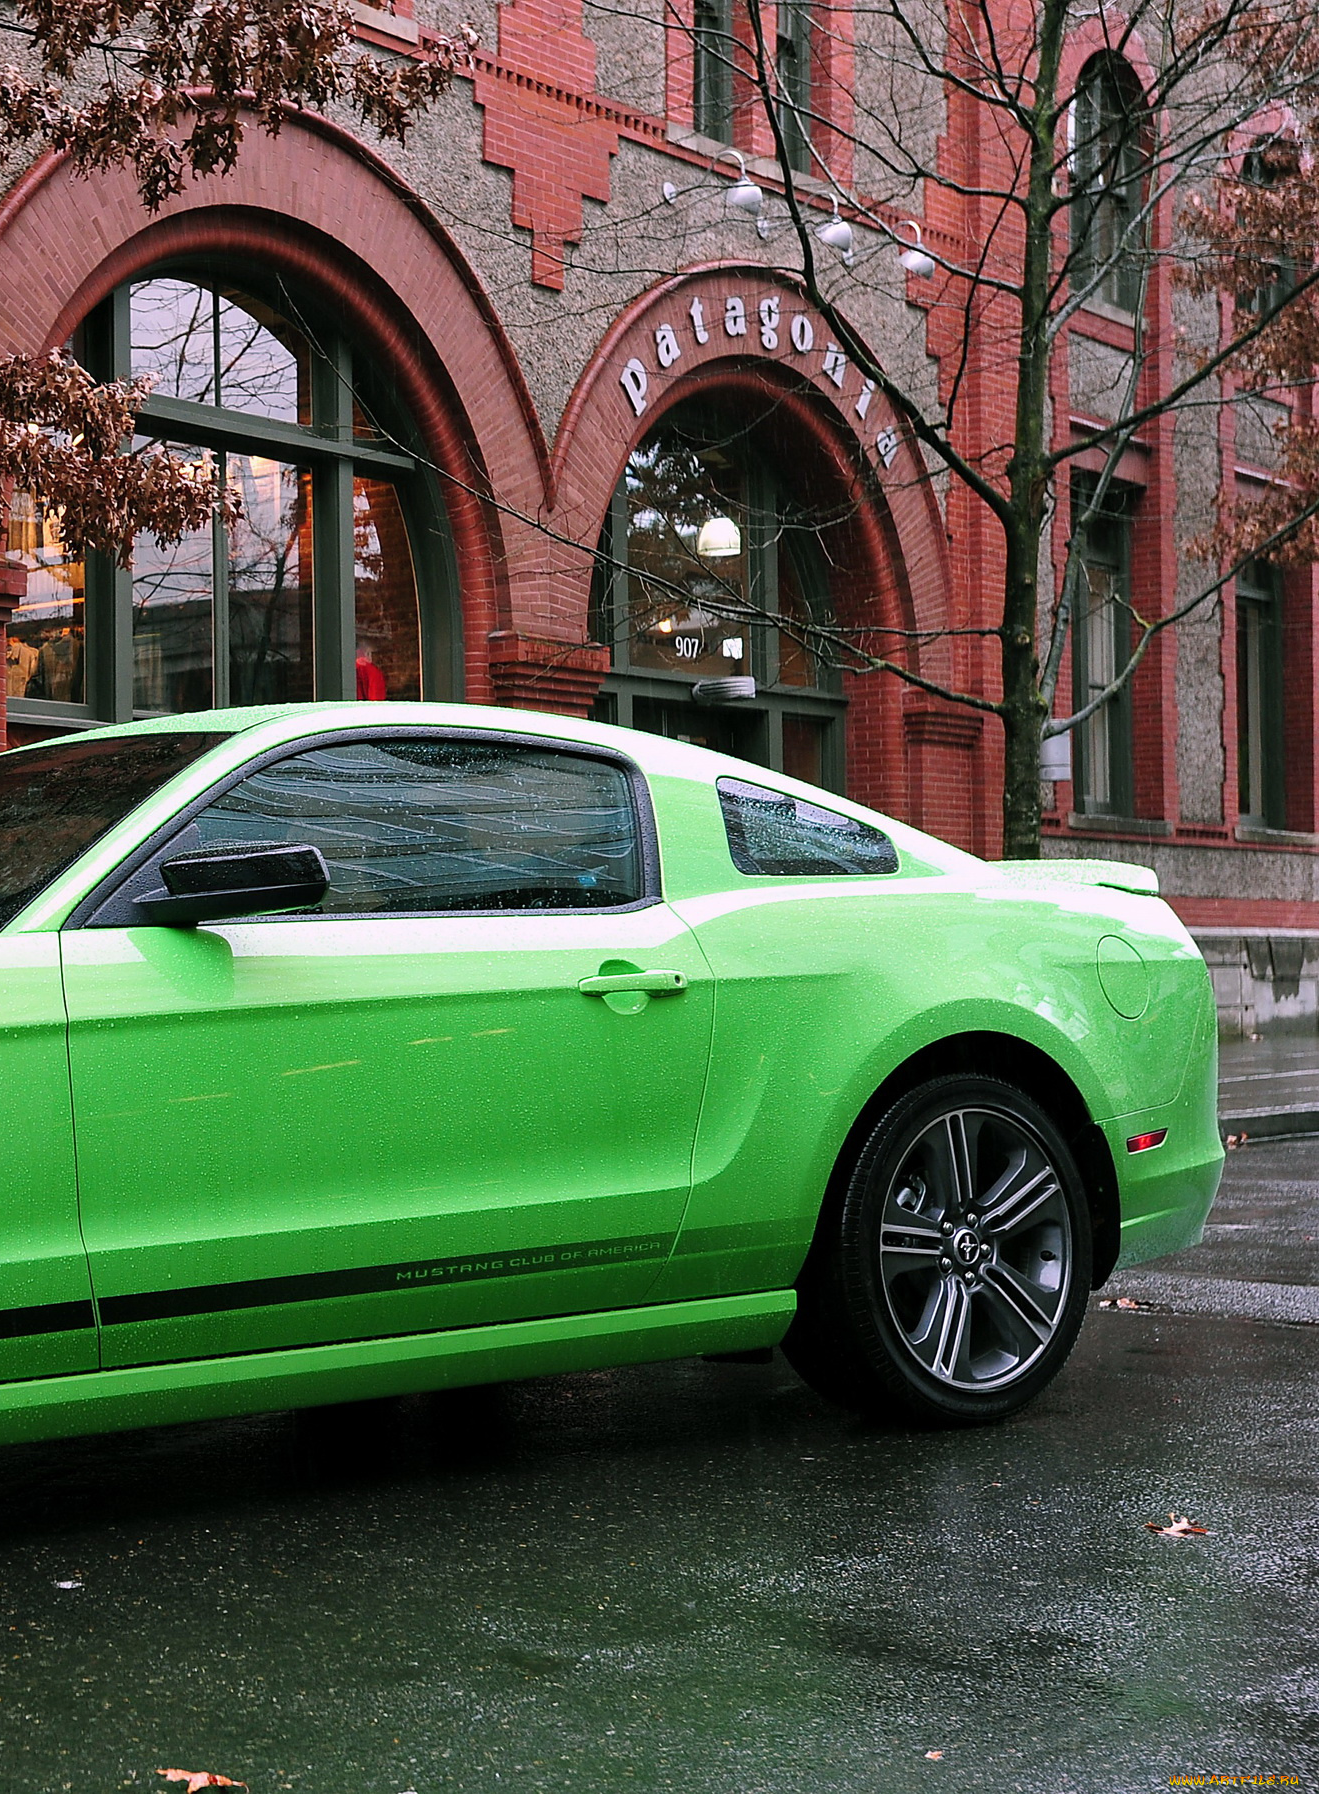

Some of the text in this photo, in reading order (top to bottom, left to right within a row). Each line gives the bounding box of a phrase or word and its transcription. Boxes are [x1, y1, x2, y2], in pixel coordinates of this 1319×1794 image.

[620, 296, 898, 469] patagonia
[675, 636, 699, 659] 907
[396, 1241, 661, 1281] MUSTANG CLUB OF AMERICA
